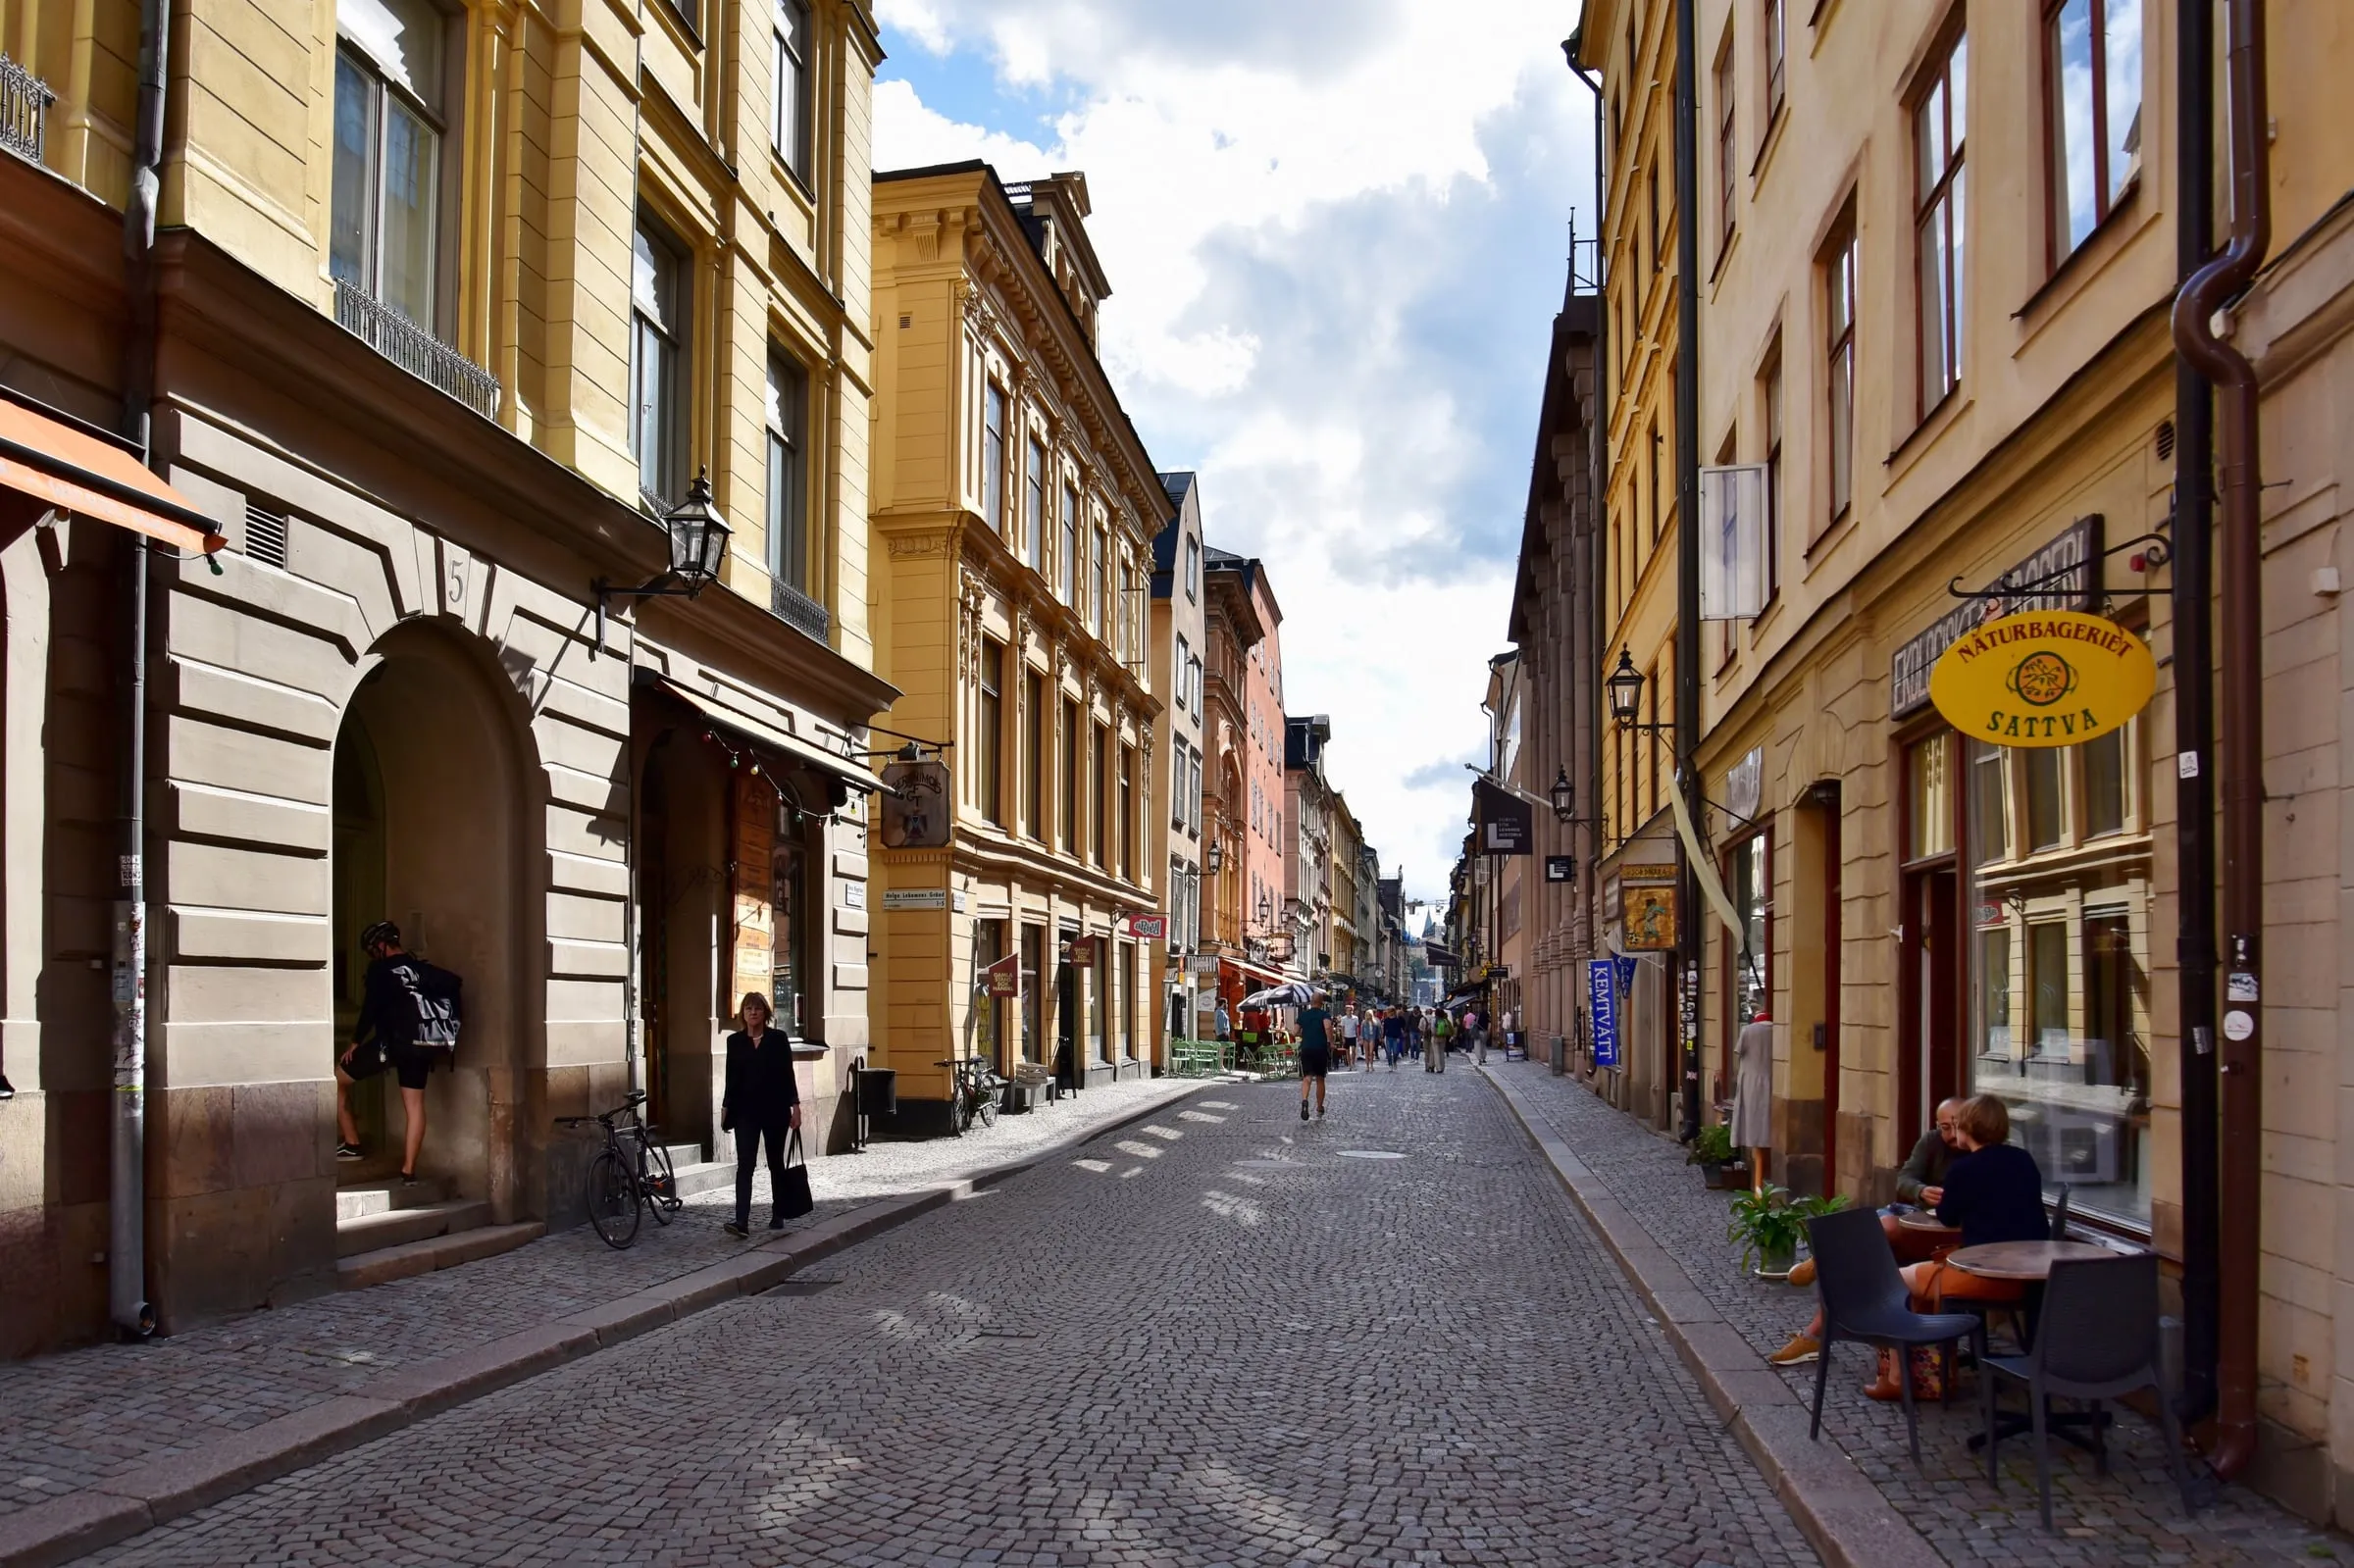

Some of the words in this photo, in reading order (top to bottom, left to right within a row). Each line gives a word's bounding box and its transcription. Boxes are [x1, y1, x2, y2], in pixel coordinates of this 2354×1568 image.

[448, 560, 463, 603] 5
[1957, 621, 2134, 664] NATURBAGERIET
[1986, 708, 2099, 737] SATTVA
[1594, 966, 1614, 1059] KEMTVÄTT
